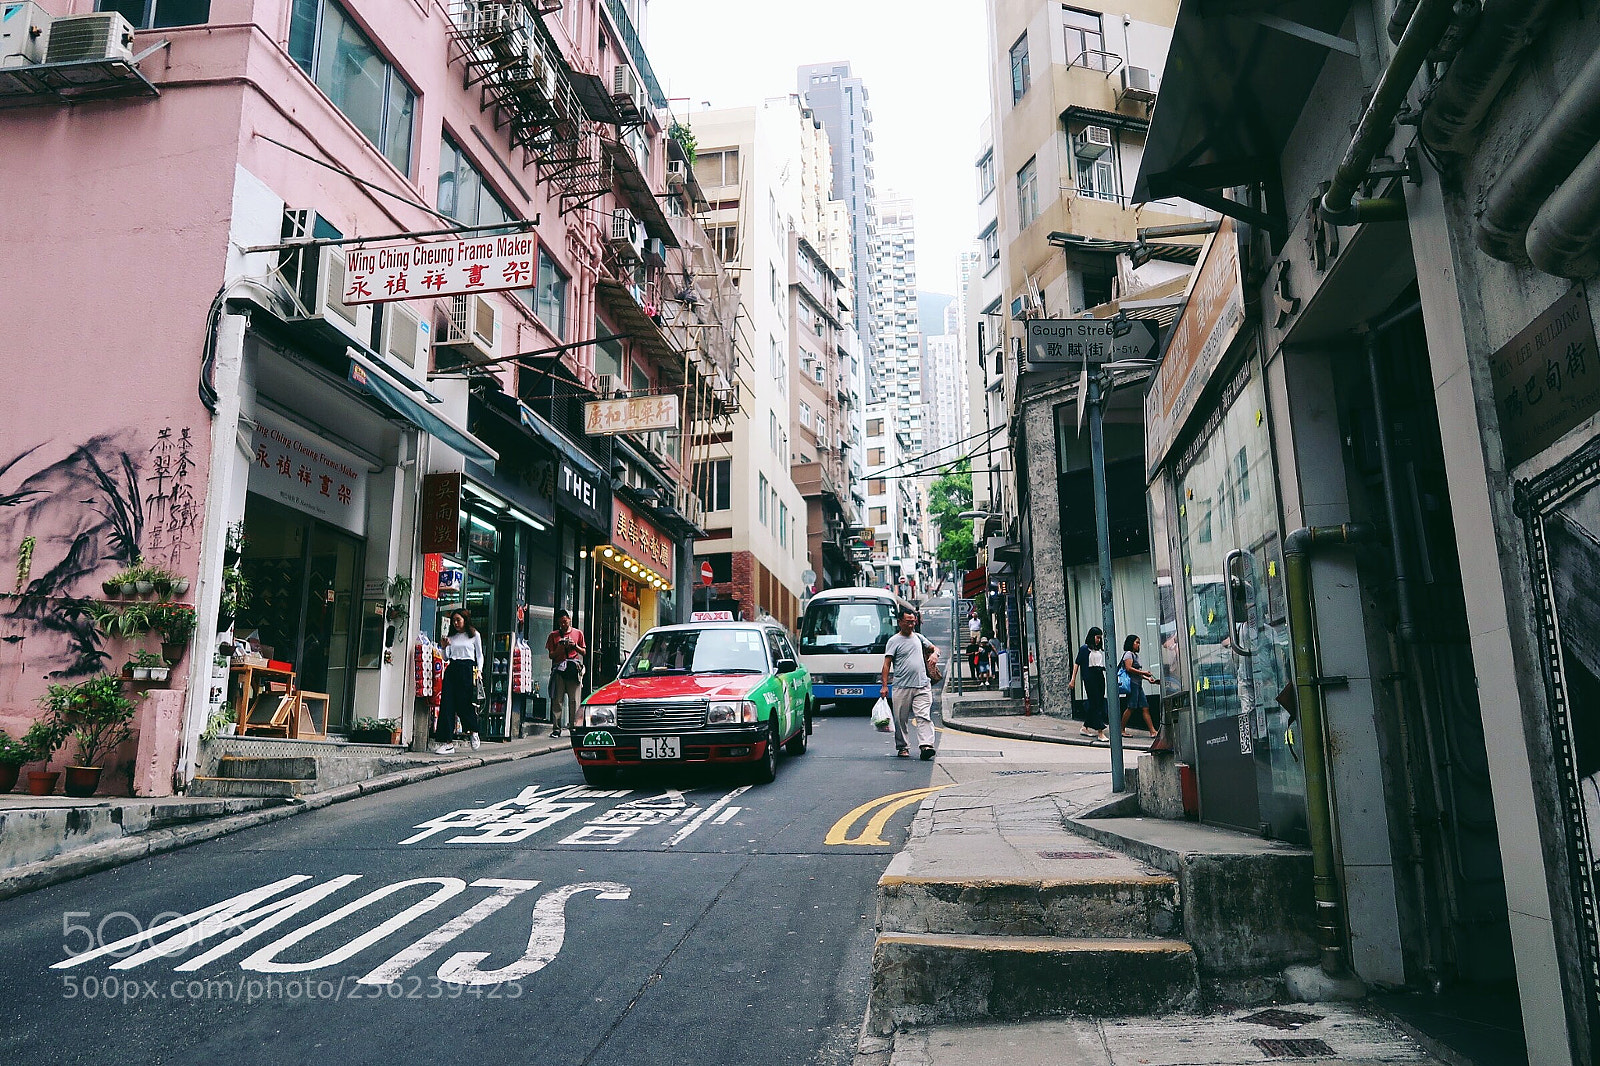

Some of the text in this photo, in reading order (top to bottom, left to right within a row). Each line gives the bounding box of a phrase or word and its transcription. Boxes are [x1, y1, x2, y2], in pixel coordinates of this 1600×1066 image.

[348, 237, 532, 274] Wing Ching Cheung Frame Maker
[1032, 325, 1114, 337] Gough Stree
[1535, 304, 1580, 349] BUILDING
[1047, 342, 1103, 357] 歌賦街
[270, 430, 291, 449] Ching
[293, 441, 319, 460] Cheung
[320, 453, 340, 470] Frame
[563, 466, 596, 510] THEI
[694, 612, 729, 620] TAXI
[652, 738, 668, 748] TX
[50, 874, 632, 987] SLOW
